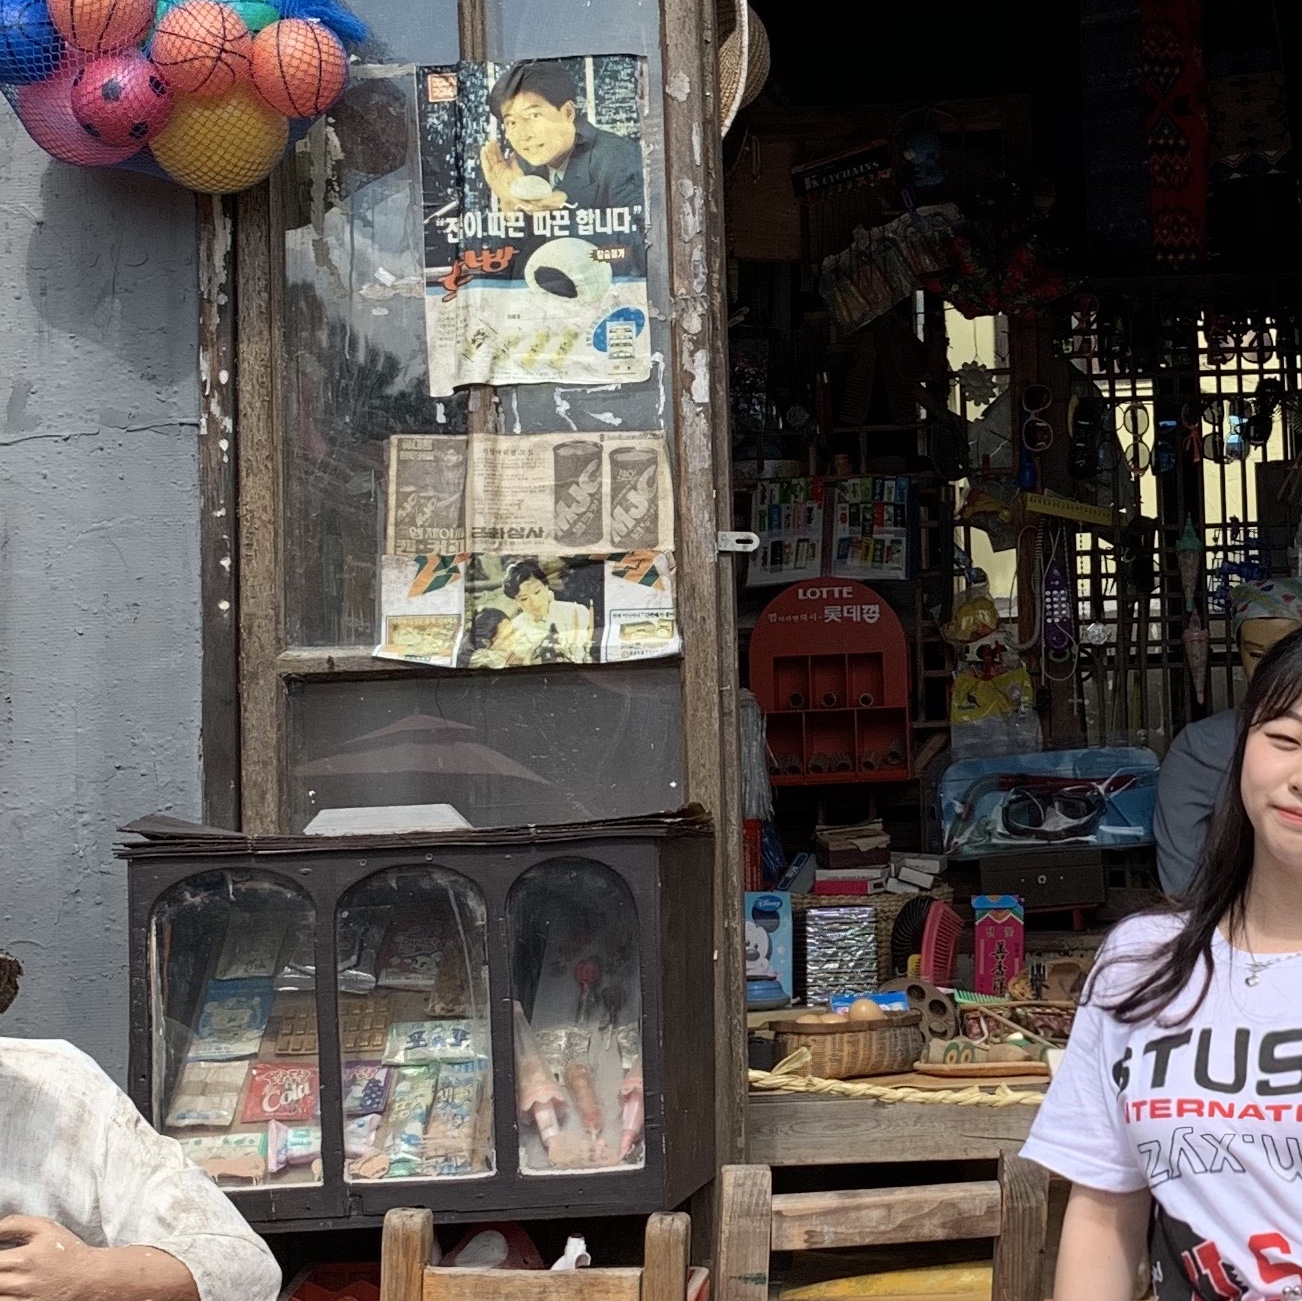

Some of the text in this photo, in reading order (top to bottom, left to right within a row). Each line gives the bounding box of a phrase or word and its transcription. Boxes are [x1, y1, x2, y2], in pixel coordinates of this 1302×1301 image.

[488, 211, 525, 238] 따끈
[533, 210, 571, 237] 따끈
[611, 464, 658, 544] MJC
[798, 586, 854, 600] LOTTE
